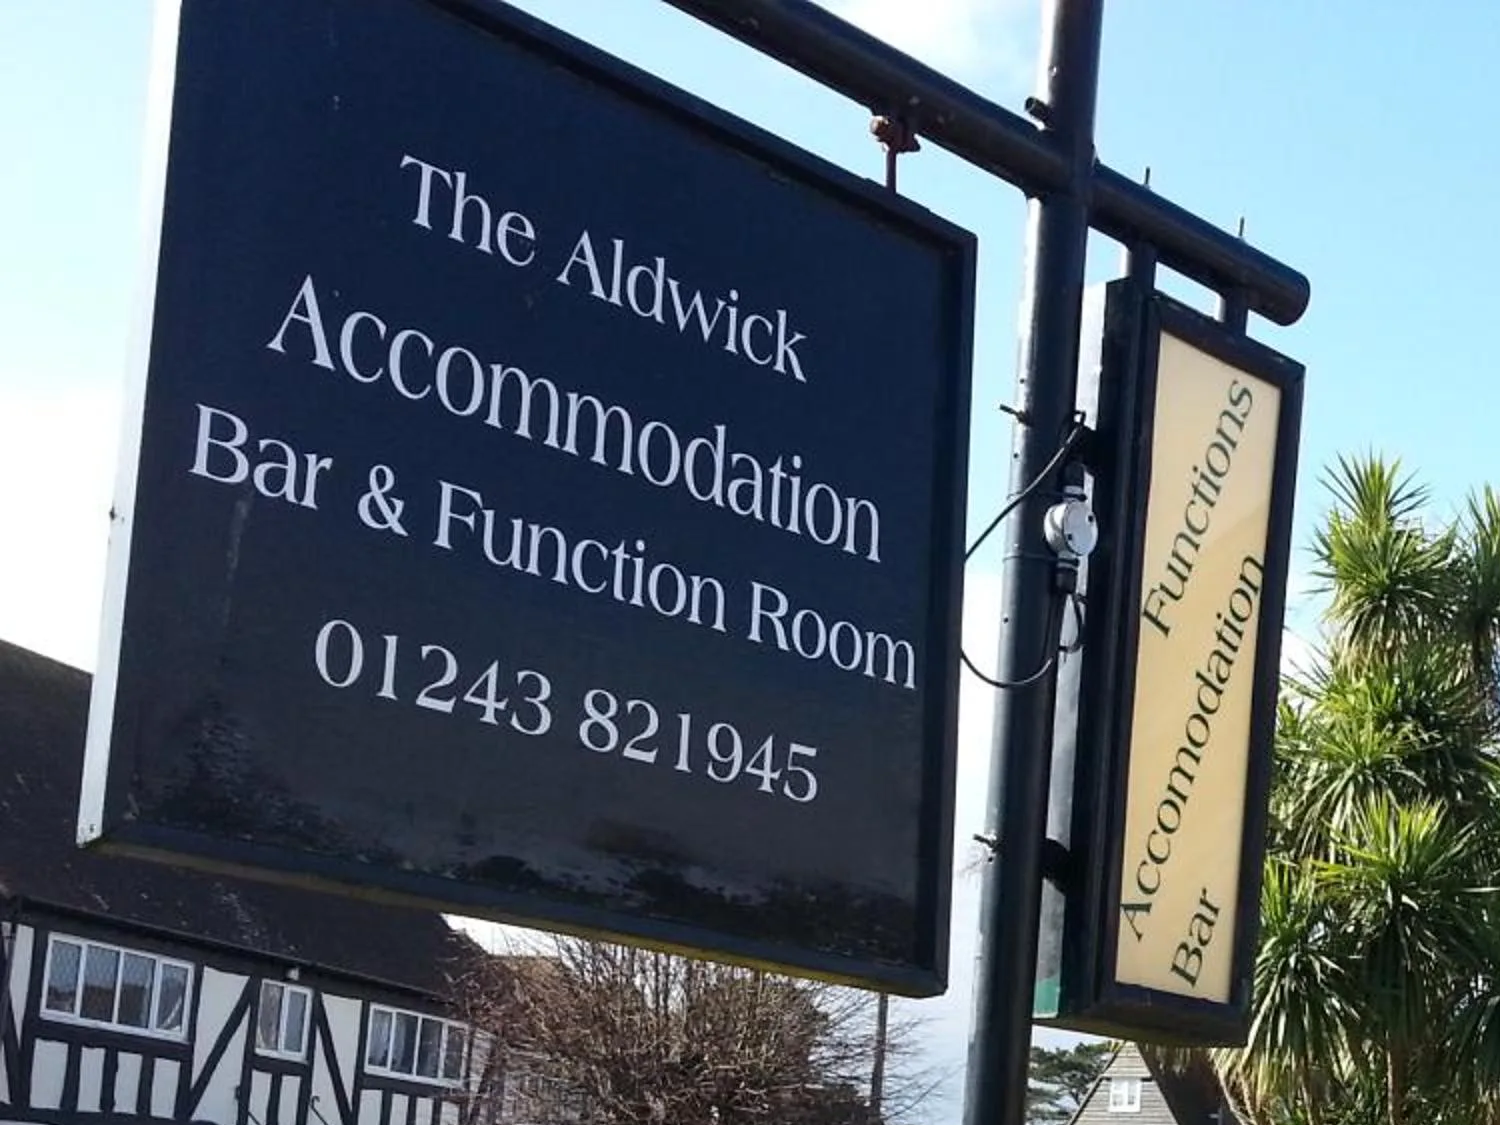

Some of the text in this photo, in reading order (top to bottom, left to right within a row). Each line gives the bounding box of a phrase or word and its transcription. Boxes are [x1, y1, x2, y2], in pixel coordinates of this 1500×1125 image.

[400, 155, 808, 383] The Aldwick
[188, 402, 916, 690] Bar & Function Room
[266, 274, 882, 564] Accommodation
[1141, 379, 1254, 639] Functions
[314, 618, 819, 803] 01243 821945
[1119, 553, 1265, 943] Accomodation
[1170, 888, 1223, 990] Bar
